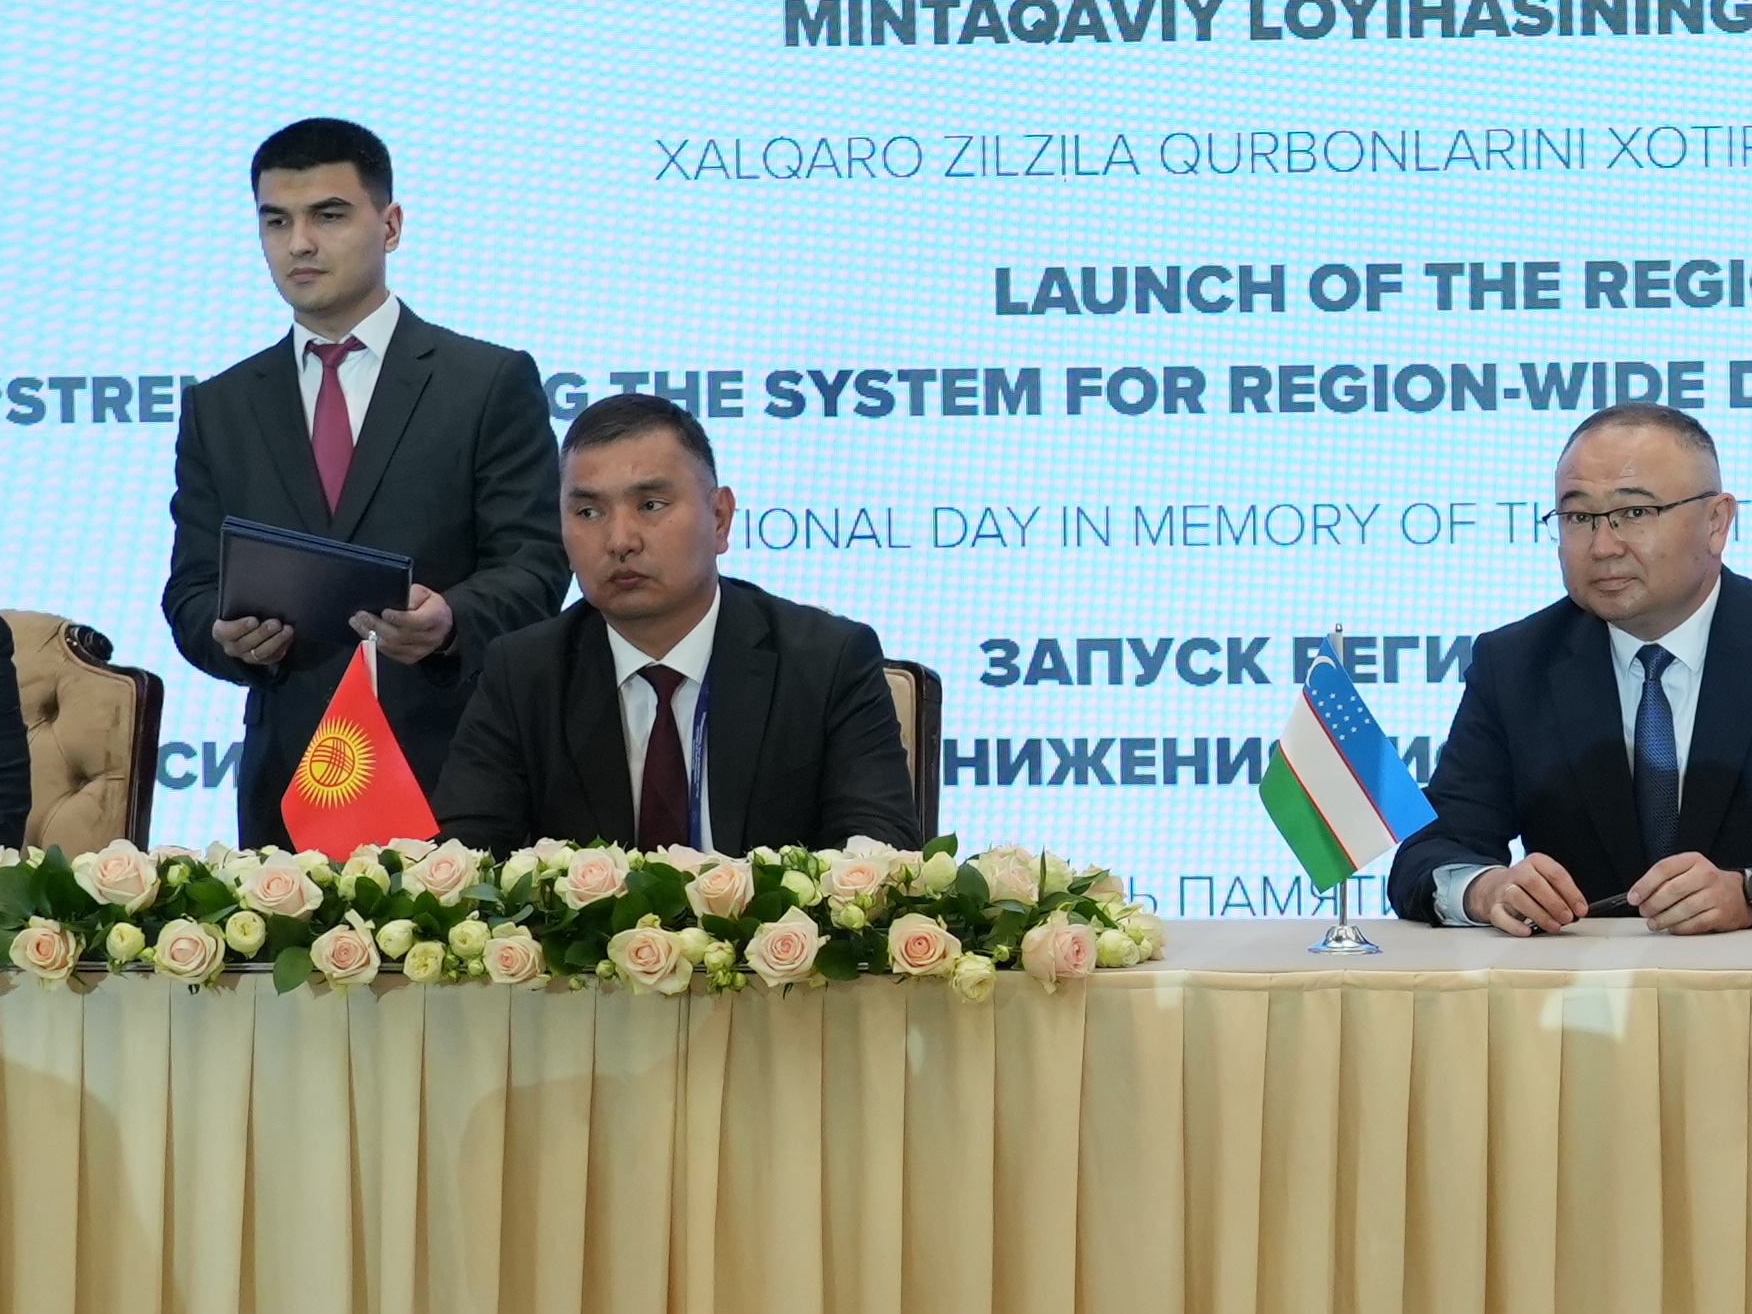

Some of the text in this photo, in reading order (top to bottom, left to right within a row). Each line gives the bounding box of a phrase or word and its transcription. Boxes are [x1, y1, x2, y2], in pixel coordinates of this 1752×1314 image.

[654, 134, 925, 181] XALQARO
[943, 132, 1141, 179] ZILZILA
[1159, 126, 1587, 176] QURBONLARINI
[995, 265, 1286, 316] LAUNCH
[1308, 263, 1403, 312] OF
[1424, 262, 1561, 311] THE
[610, 370, 743, 417] THE
[765, 367, 1042, 420] SYSTEM
[1066, 366, 1206, 416] FOR
[1229, 360, 1705, 415] REGION-WIDE
[931, 504, 1040, 550] DAY
[1061, 504, 1112, 548] IN
[1132, 501, 1381, 549] MEMORY
[1399, 501, 1477, 546] OF
[980, 637, 1269, 688] ЗАПУСК
